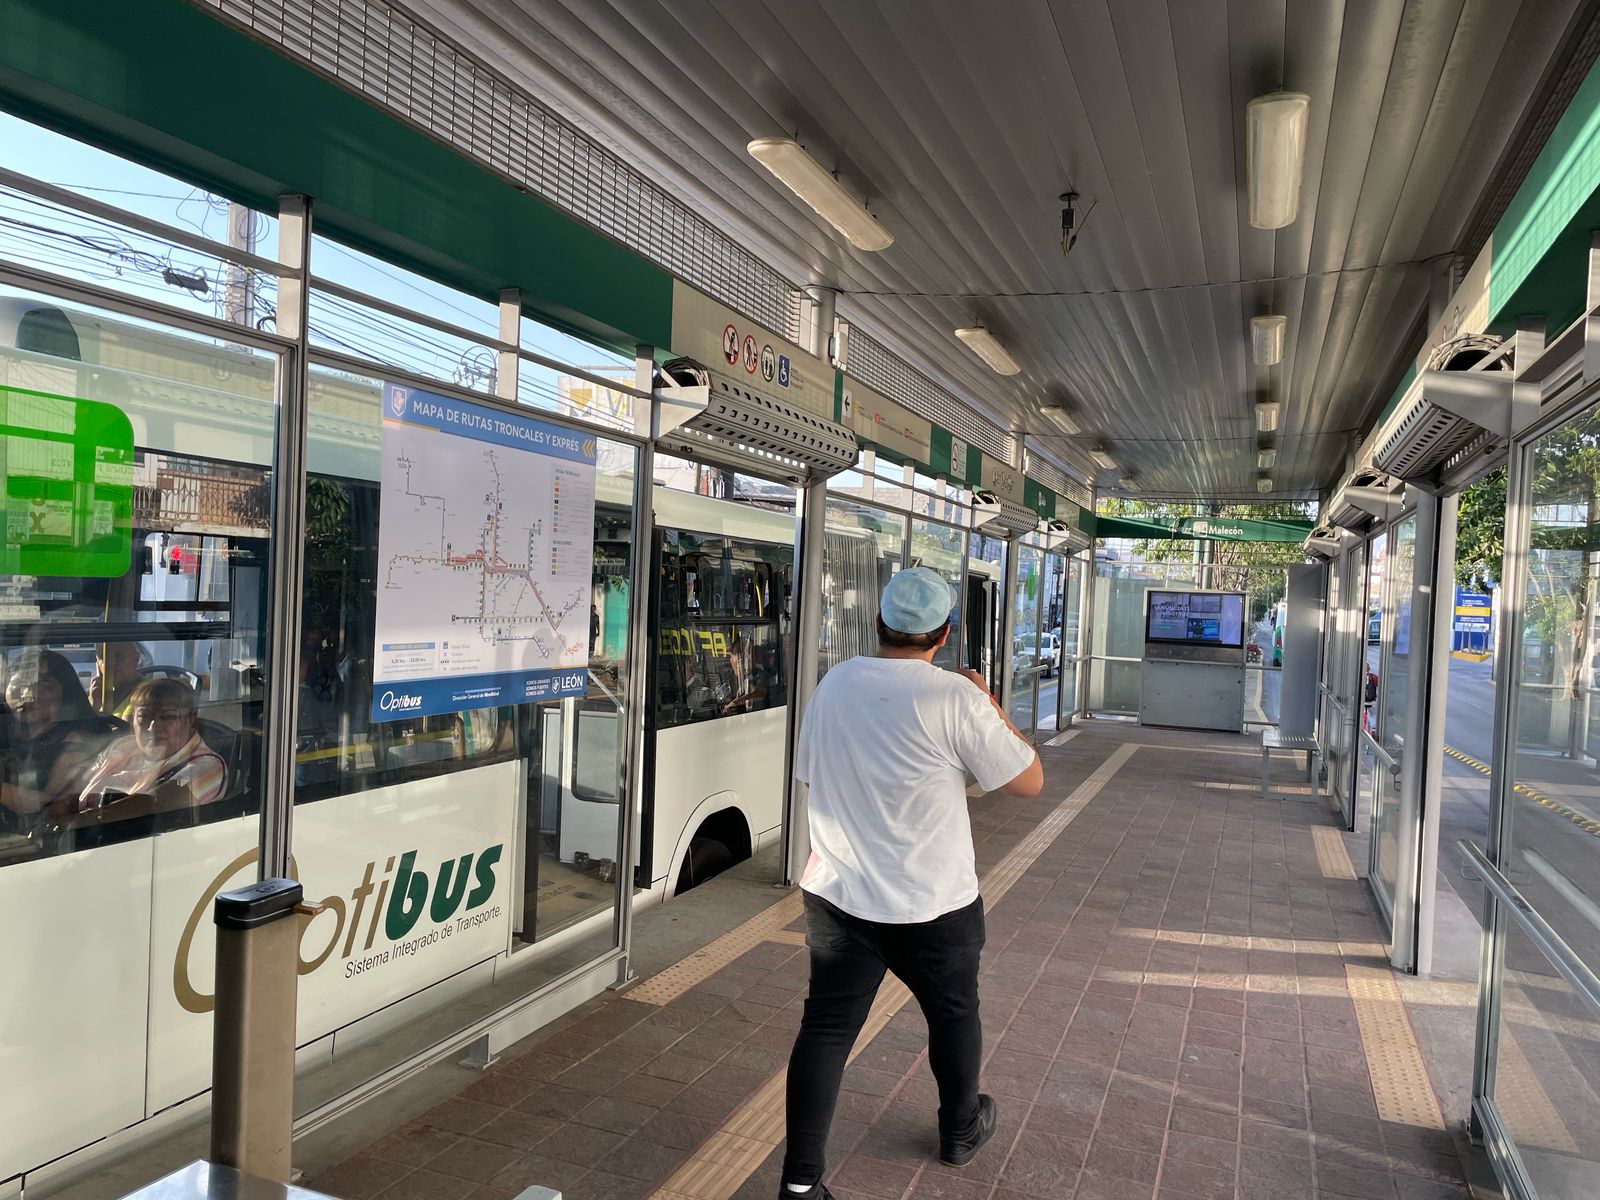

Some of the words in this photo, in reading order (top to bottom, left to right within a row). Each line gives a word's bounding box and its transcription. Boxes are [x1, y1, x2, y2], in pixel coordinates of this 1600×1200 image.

[413, 400, 444, 420] MAPA
[447, 409, 459, 423] DE
[461, 411, 492, 431] RUTAS
[494, 421, 544, 443] TRONCALES
[545, 434, 551, 444] Y
[552, 436, 579, 451] EXPRÉS
[1208, 525, 1243, 535] Malecón
[561, 673, 584, 689] LEÓN
[380, 690, 422, 711] Optibus
[345, 951, 389, 979] Sistema
[392, 929, 439, 960] Integrado
[441, 925, 453, 940] de
[456, 906, 502, 934] Transporte.
